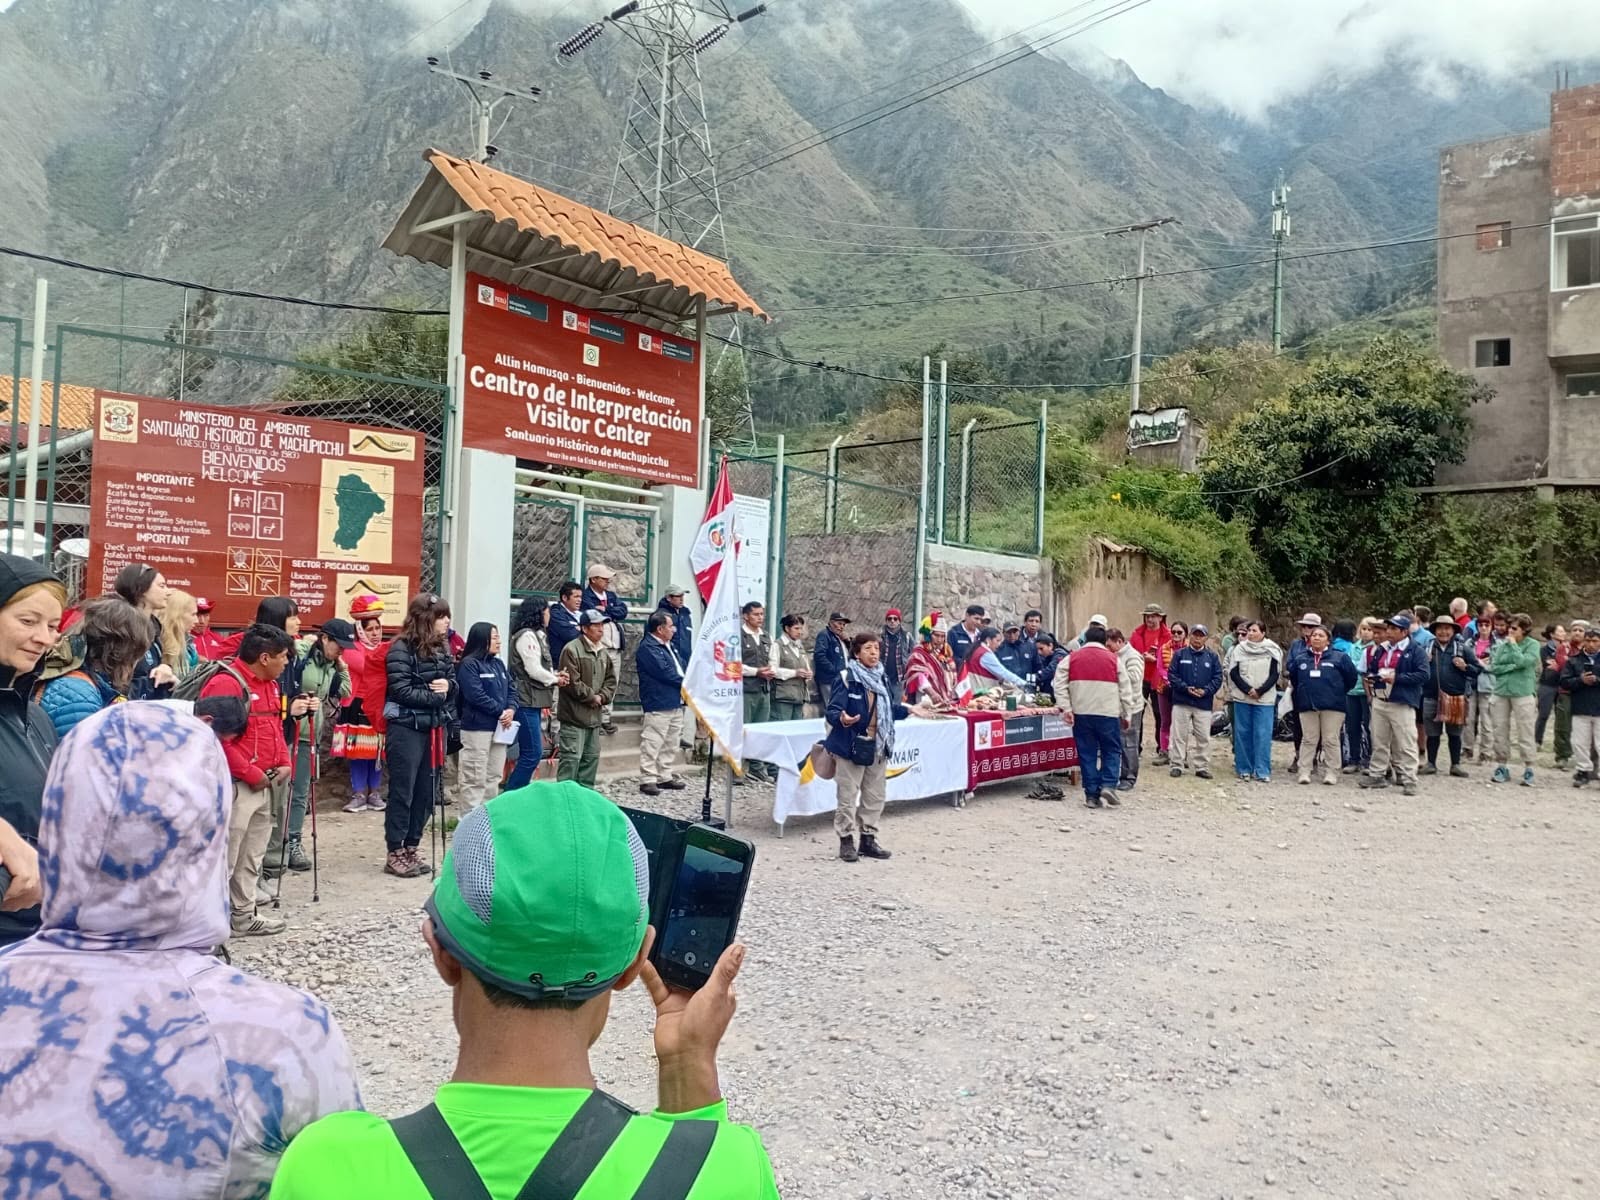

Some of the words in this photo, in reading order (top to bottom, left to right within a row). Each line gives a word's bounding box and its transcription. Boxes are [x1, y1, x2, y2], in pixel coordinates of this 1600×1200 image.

[494, 353, 520, 370] Allin
[522, 360, 568, 382] Hamusqa
[637, 388, 676, 406] Welcome
[470, 366, 540, 400] Centro
[544, 382, 566, 406] de
[571, 388, 692, 434] Interpretación
[142, 419, 199, 439] SANTUARIO
[205, 427, 254, 446] HISTORICO
[260, 434, 274, 448] DE
[280, 436, 344, 456] MACHUPICCHU
[180, 410, 234, 428] MINISTERIO
[240, 418, 258, 432] DEL
[264, 421, 311, 438] AMBIENTE
[526, 402, 590, 434] Visitor
[594, 418, 652, 446] Center
[176, 438, 208, 450] (UNESCO
[210, 441, 220, 450] 09
[505, 426, 555, 446] Santuario
[556, 436, 598, 454] Histórico
[600, 445, 612, 456] de
[613, 448, 669, 468] Machupicchu
[202, 450, 286, 472] BIENVENIDOS
[136, 472, 195, 486] IMPORTANTE
[202, 466, 264, 486] WELCOME
[136, 532, 190, 545] IMPORTANT
[701, 615, 728, 642] Ministerio
[714, 688, 741, 698] SERN
